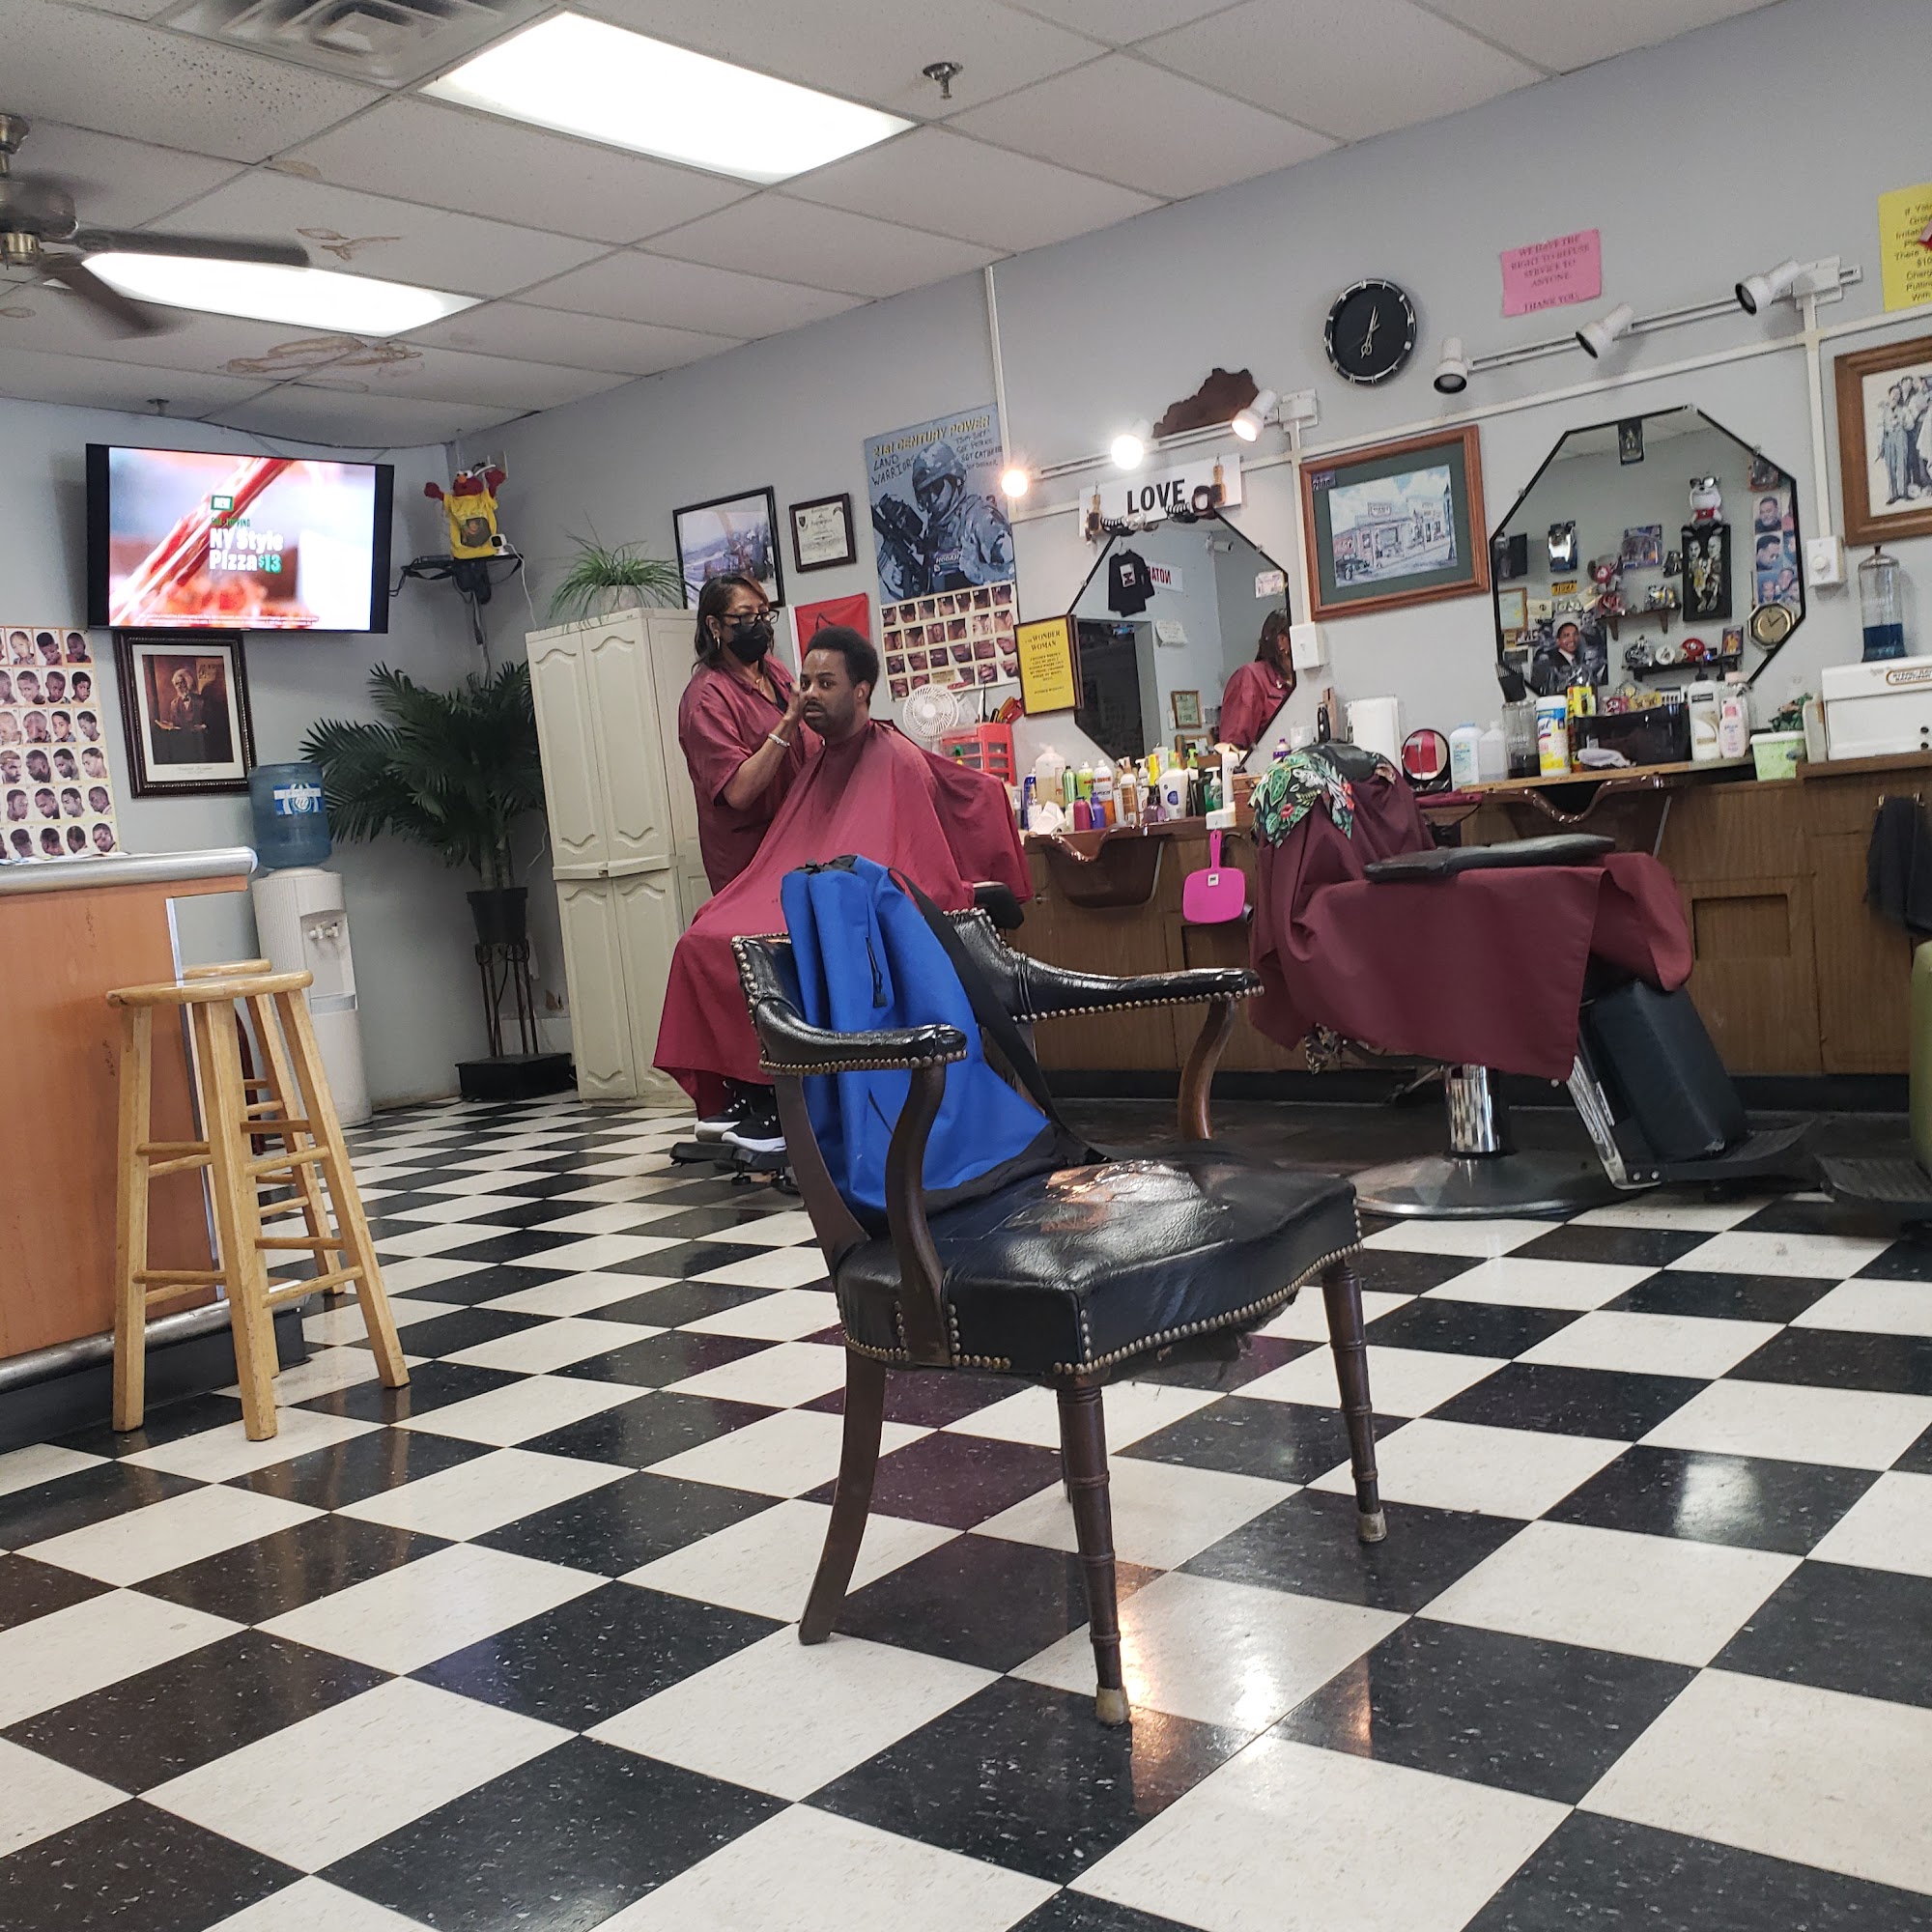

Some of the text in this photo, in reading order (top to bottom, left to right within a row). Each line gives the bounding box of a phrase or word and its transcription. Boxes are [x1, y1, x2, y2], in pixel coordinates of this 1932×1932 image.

[1524, 298, 1555, 311] THANK
[897, 427, 947, 450] CENTURY
[950, 415, 990, 437] POWER
[873, 454, 899, 471] LAND
[1126, 479, 1185, 515] LOVE
[210, 527, 284, 554] NY Style
[209, 549, 282, 574] Pizza $13
[1031, 639, 1057, 651] WOMAN
[1032, 630, 1061, 642] WONDER
